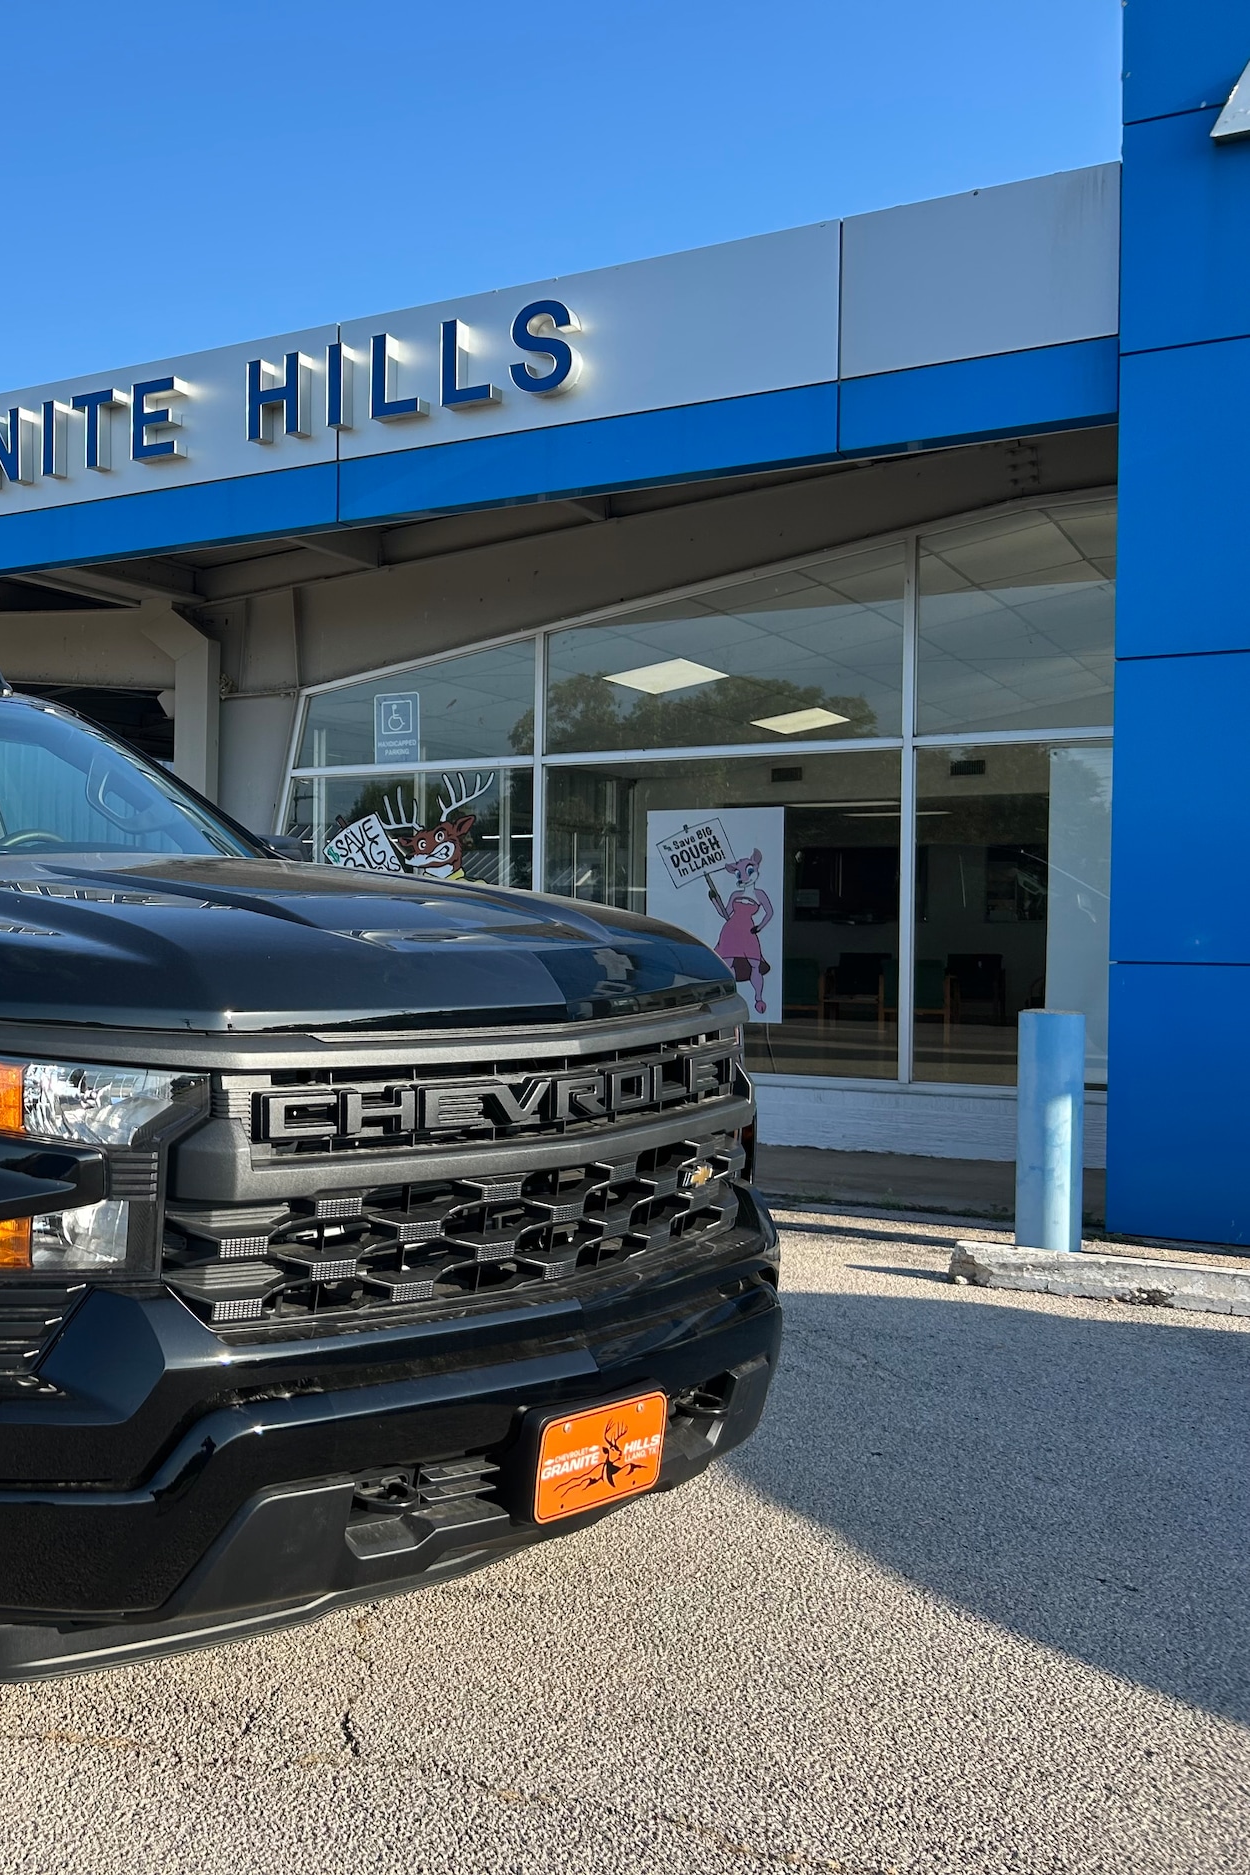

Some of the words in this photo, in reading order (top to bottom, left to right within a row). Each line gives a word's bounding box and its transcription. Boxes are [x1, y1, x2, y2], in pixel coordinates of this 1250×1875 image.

[245, 298, 583, 446] HILLS
[377, 739, 417, 748] HANDICAPPED
[384, 748, 410, 756] PARKING
[335, 818, 380, 859] SAVE
[672, 834, 696, 850] Save
[695, 826, 713, 840] BIG
[670, 835, 721, 868] DOUGH
[688, 850, 726, 873] LLANO!
[541, 1451, 600, 1480] GRANITE
[623, 1434, 661, 1455] HILLS
[554, 1446, 589, 1463] CHEVROLET
